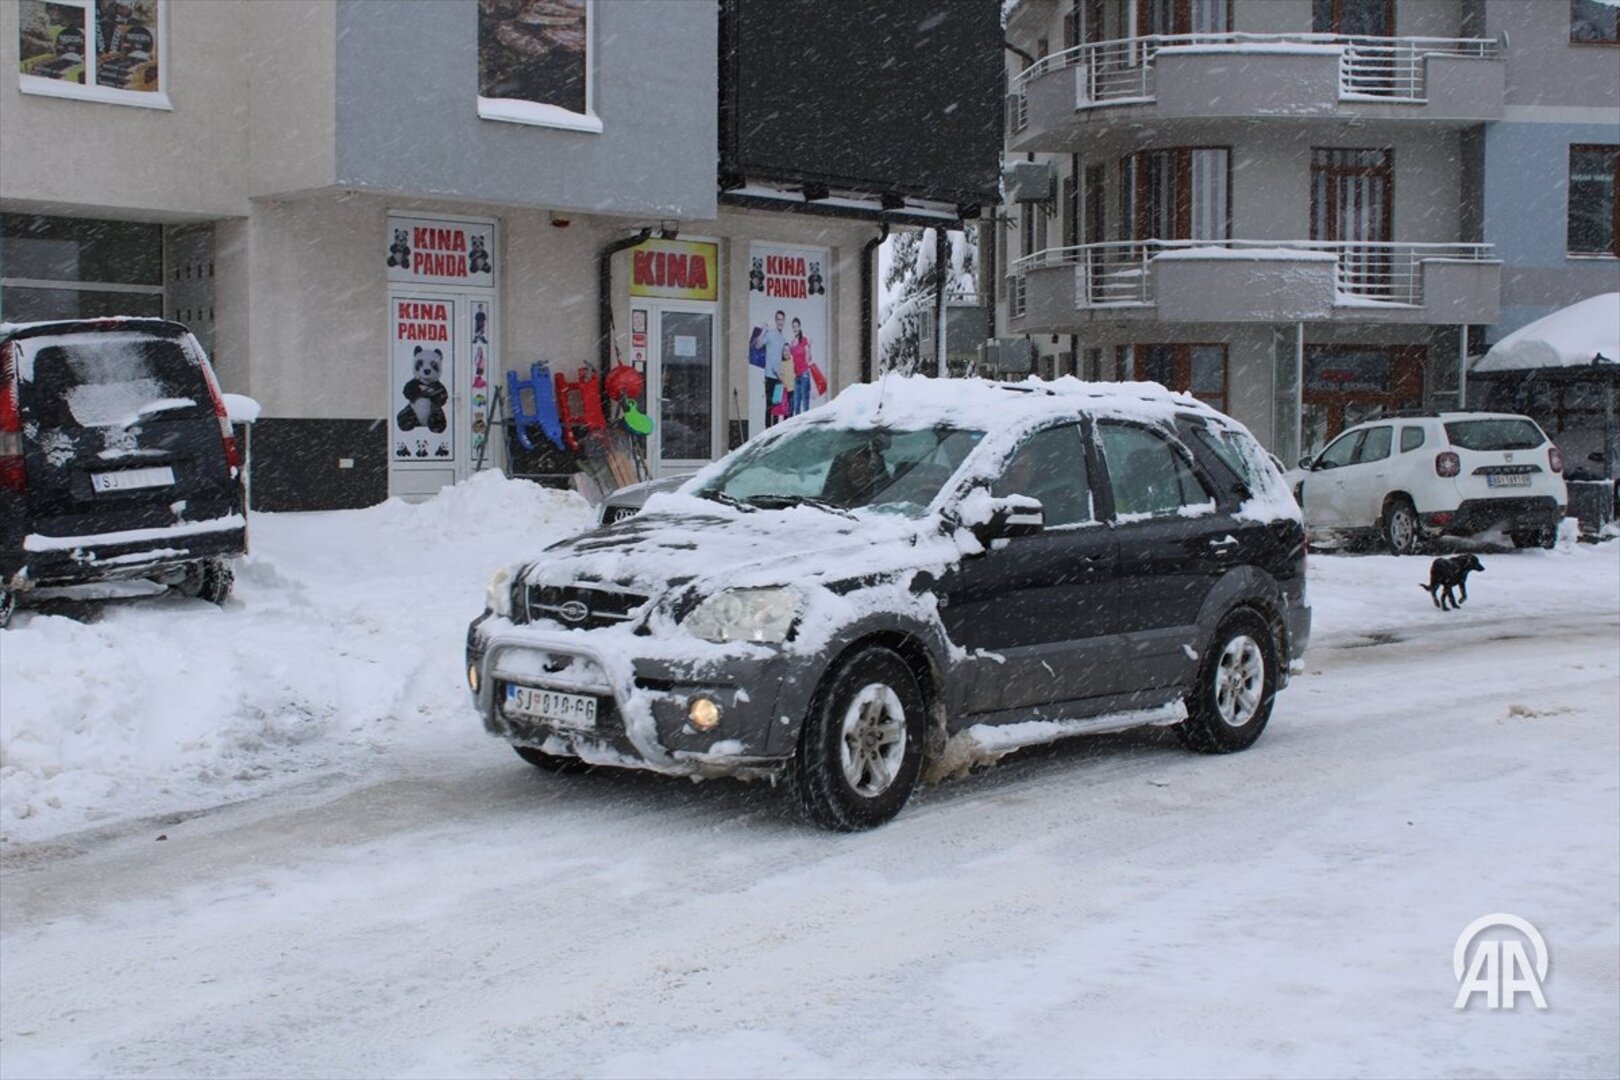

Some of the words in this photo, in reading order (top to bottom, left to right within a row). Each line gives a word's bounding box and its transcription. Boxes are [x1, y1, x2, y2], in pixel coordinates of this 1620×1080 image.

[414, 227, 467, 253] KINA
[414, 252, 468, 277] PANDA
[634, 251, 708, 289] KINA
[766, 256, 807, 277] KINA
[766, 277, 807, 299] PANDA
[398, 302, 448, 321] KINA
[398, 322, 448, 342] PANDA
